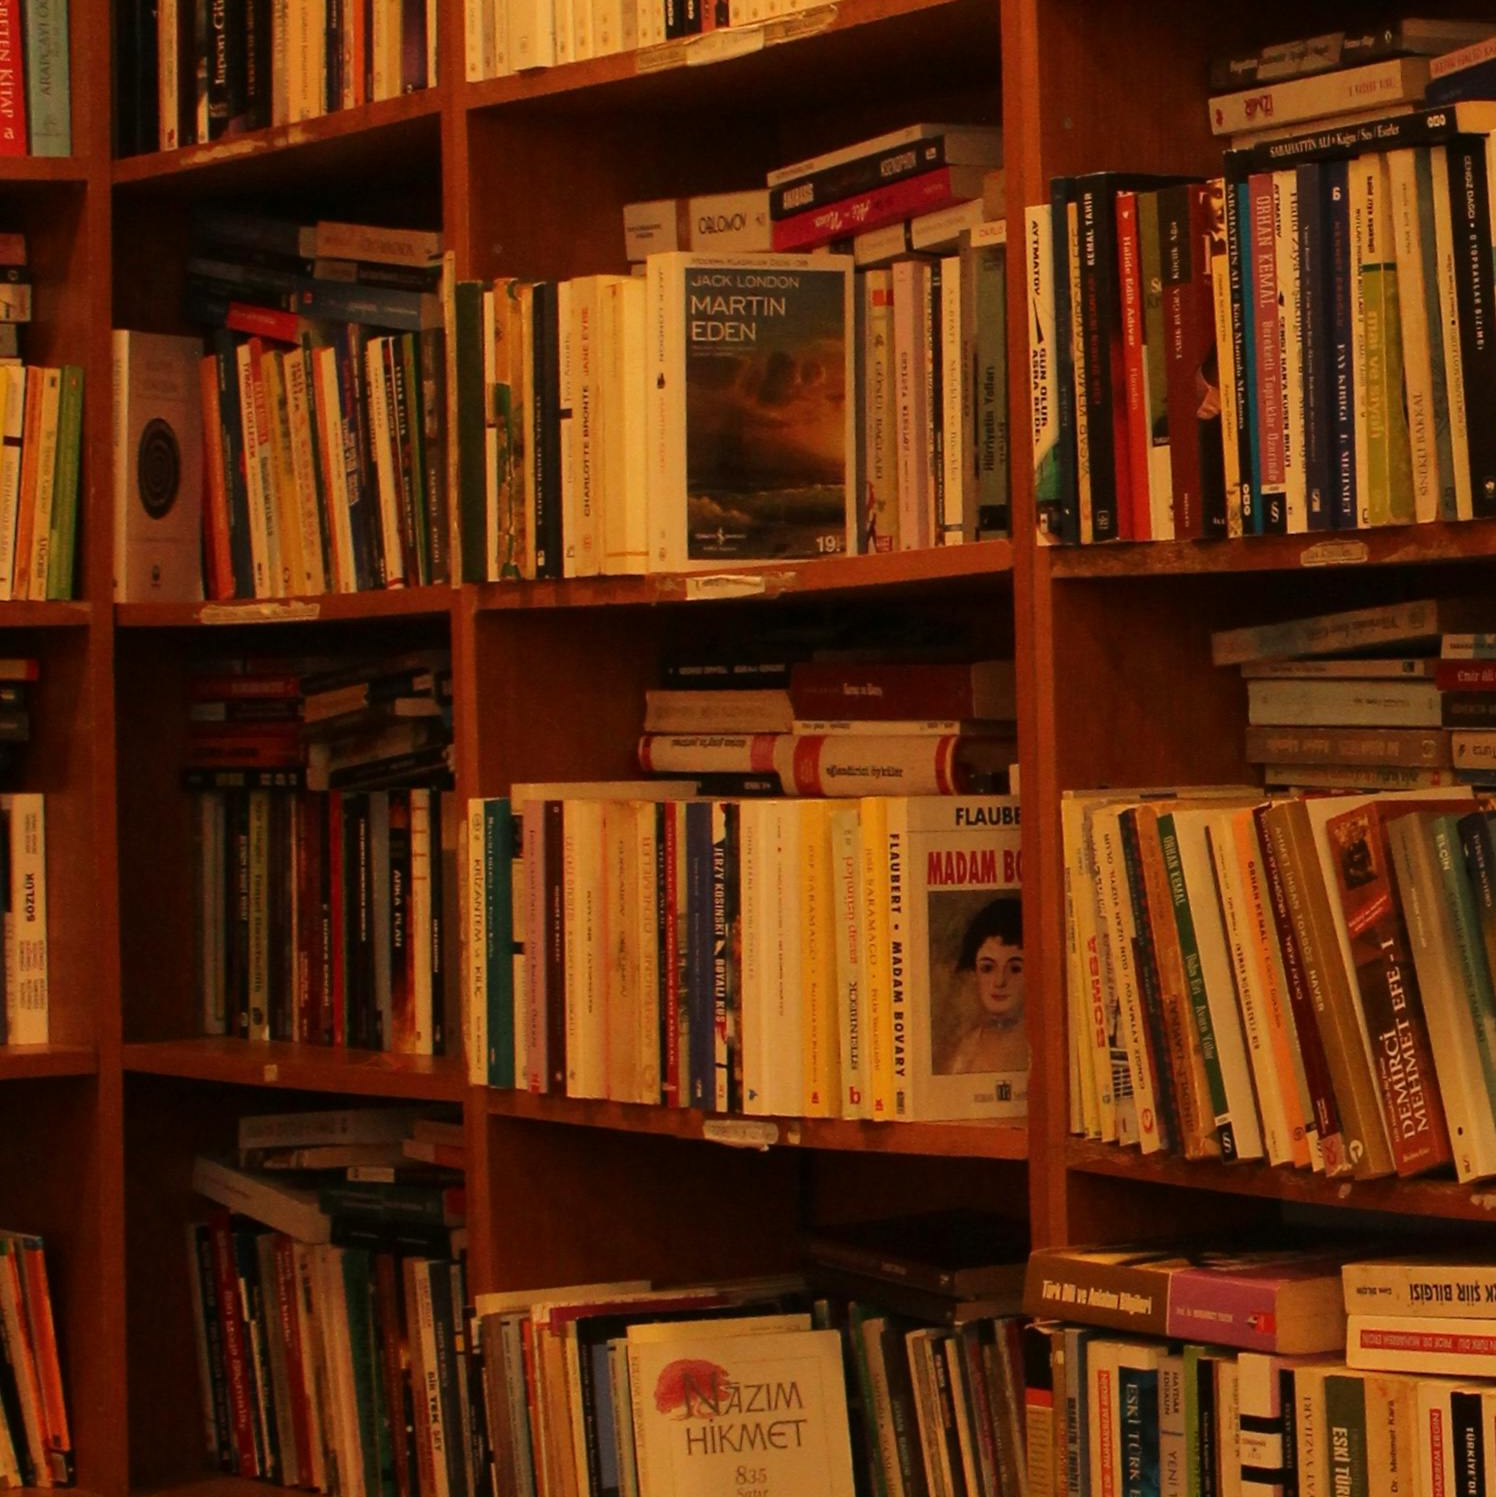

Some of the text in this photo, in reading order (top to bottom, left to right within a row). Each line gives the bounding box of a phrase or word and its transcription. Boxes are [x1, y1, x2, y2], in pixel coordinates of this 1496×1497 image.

[1254, 195, 1276, 307] ORHAN KEMAL
[690, 295, 787, 316] MARTIN
[691, 321, 757, 341] EDEN
[928, 849, 998, 886] MADAM
[892, 1010, 906, 1078] BOVARY
[687, 1418, 807, 1456] HİKMET
[1331, 1427, 1353, 1462] ESKİ
[735, 1467, 768, 1485] 835
